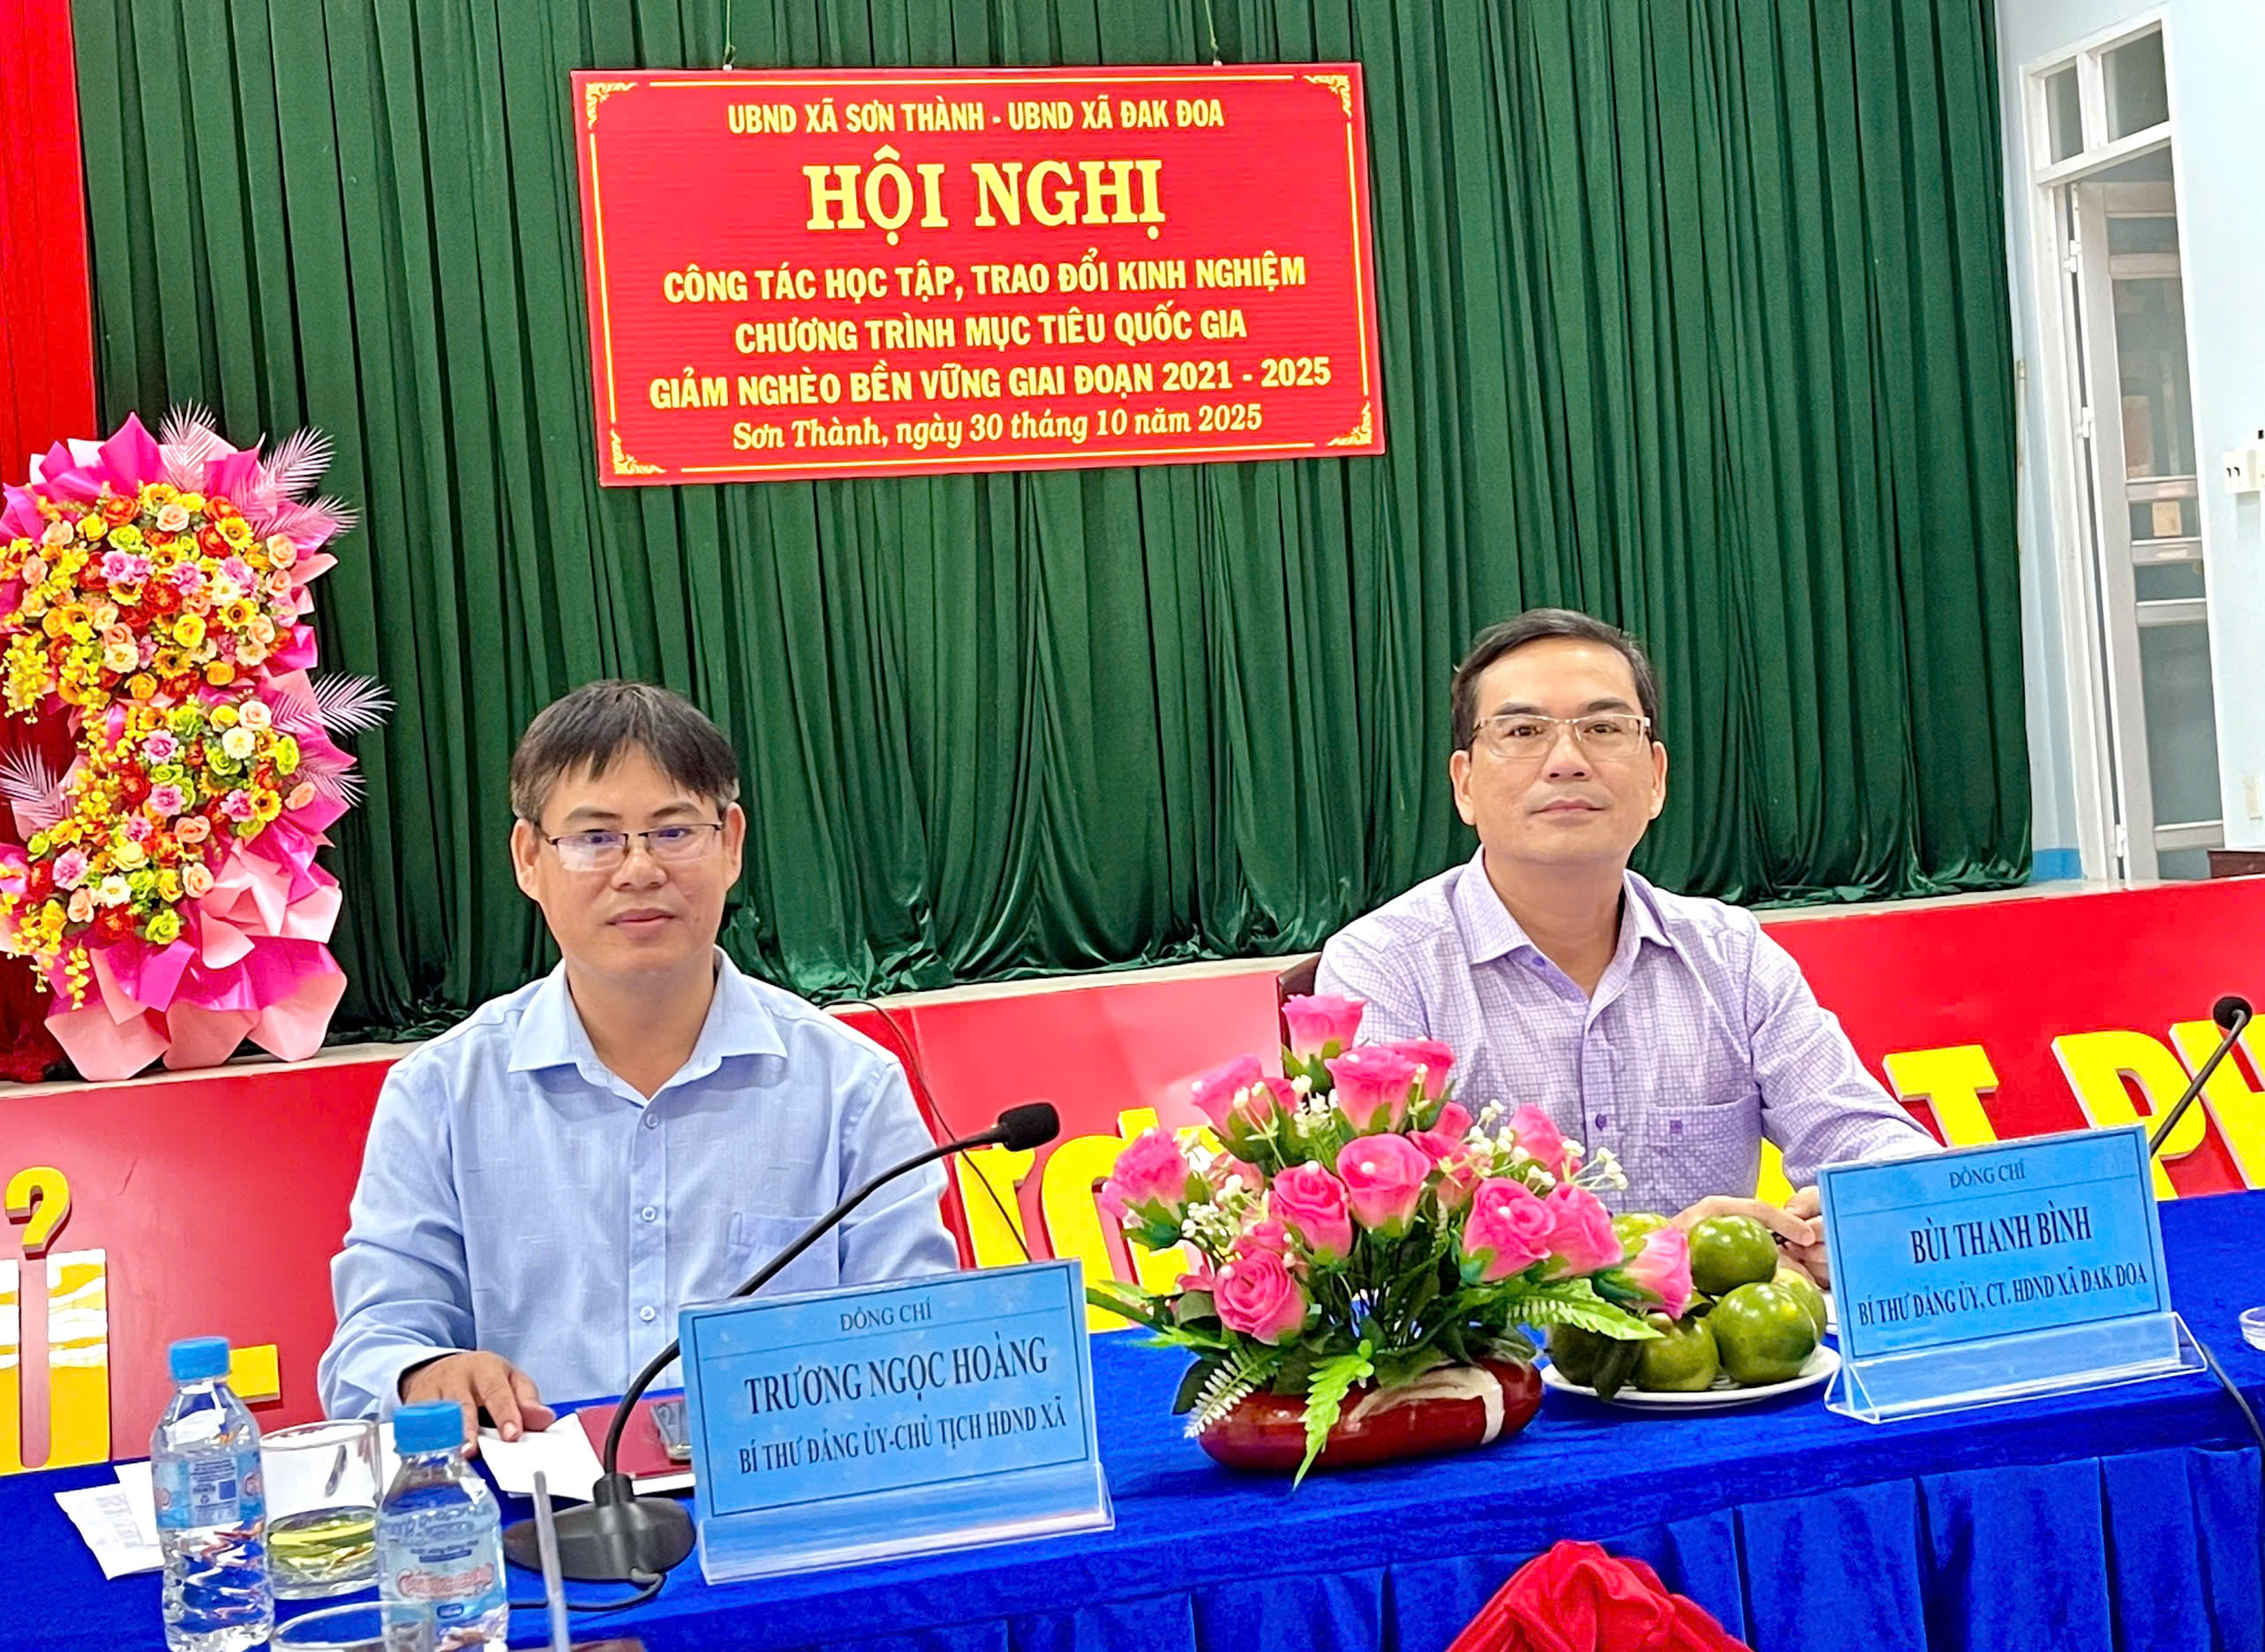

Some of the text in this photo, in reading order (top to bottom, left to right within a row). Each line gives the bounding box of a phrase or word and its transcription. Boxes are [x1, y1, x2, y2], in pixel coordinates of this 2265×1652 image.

[728, 103, 797, 134] UBND
[804, 96, 839, 133] XÃ
[845, 99, 896, 133] SƠN
[899, 94, 985, 131] THÀNH
[1008, 101, 1074, 131] UBND
[1080, 94, 1113, 130] XÃ
[1119, 99, 1170, 129] ĐAK
[1176, 99, 1224, 129] ĐOA
[802, 144, 1166, 246] HỘI NGHỊ
[663, 246, 1306, 304] CÔNG TÁC HỌC TẬP, TRAO ĐỔI KINH NGHIỆM
[735, 300, 1247, 354] CHƯƠNG TRÌNH MỤC TIÊU QUỐC GIA
[649, 366, 728, 409] GIẢM
[737, 366, 841, 406] NGHÈO
[849, 359, 913, 402] BỀN
[919, 363, 1001, 400] VỮNG
[1008, 365, 1065, 397] GIAI
[1072, 363, 1154, 399] ĐOẠN
[1162, 360, 1233, 391] 2021
[1260, 357, 1332, 387] 2025
[733, 402, 1262, 451] Sơn Thành, ngày 30 tháng 10 năm 2025
